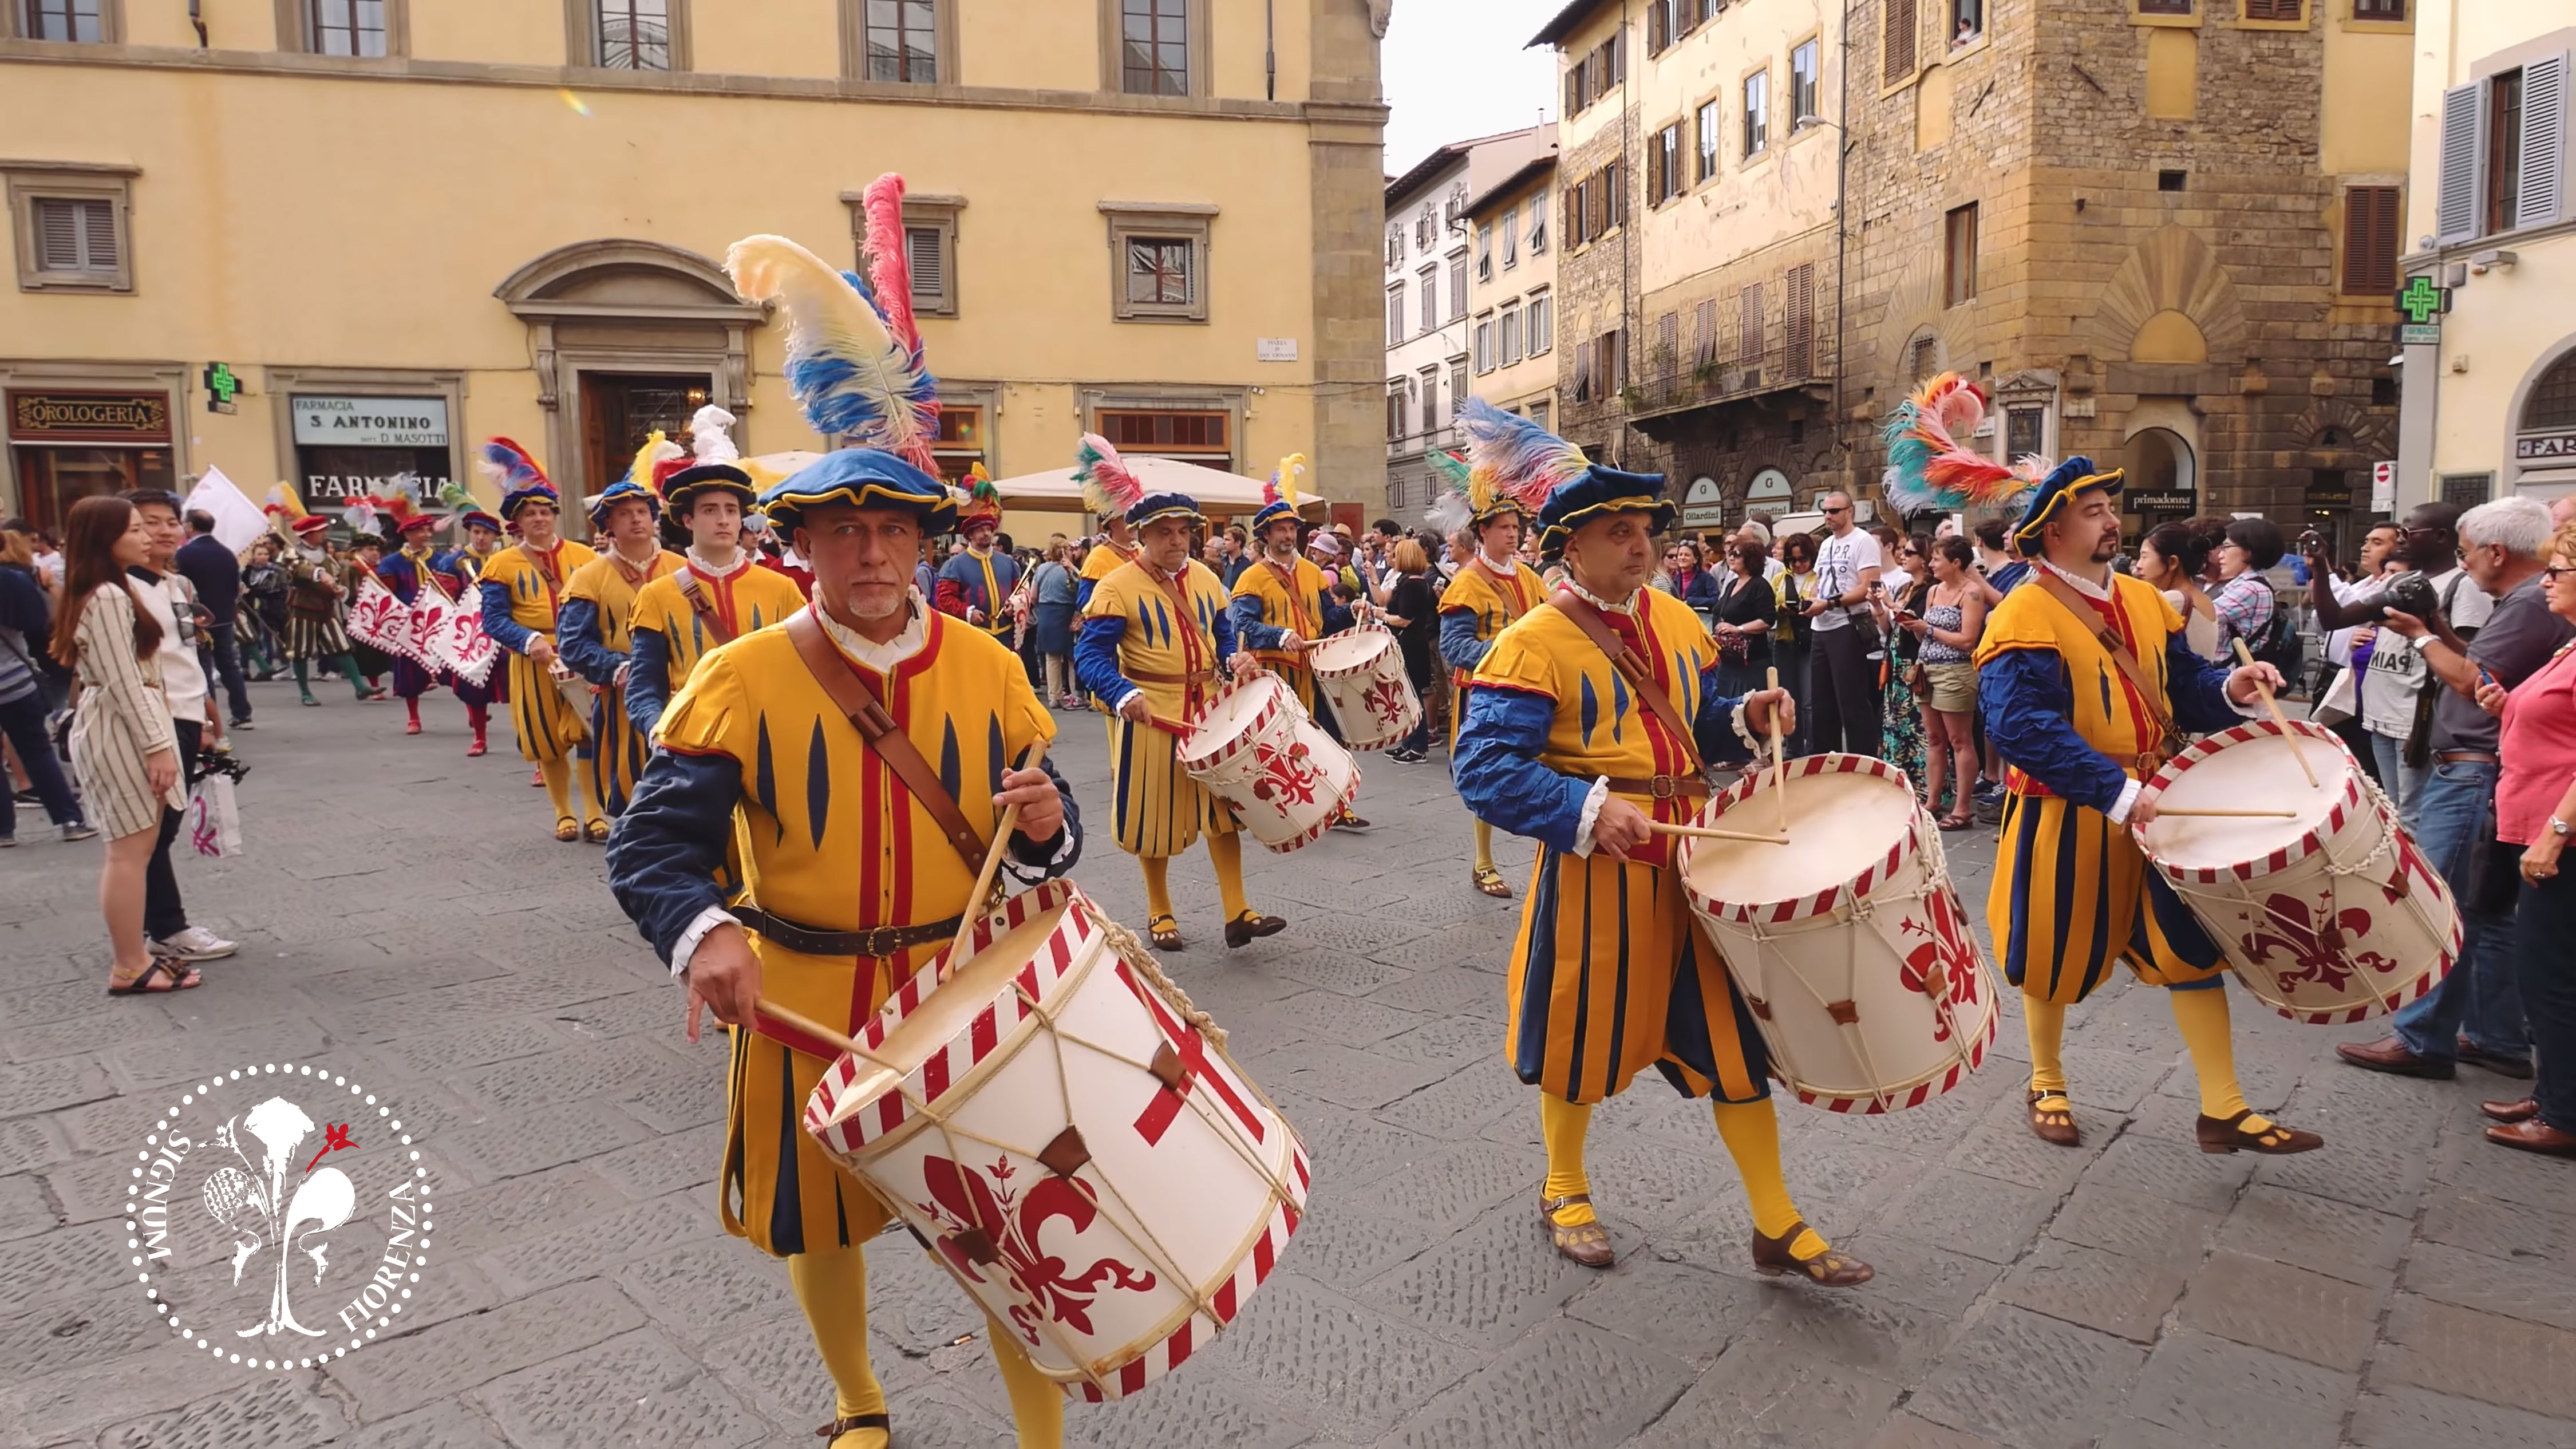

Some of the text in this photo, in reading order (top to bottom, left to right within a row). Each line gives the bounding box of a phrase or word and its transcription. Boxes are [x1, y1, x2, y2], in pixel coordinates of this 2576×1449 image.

[296, 400, 354, 411] FARMACIA
[33, 405, 148, 422] OROLOGERIA
[333, 416, 430, 429] ANTONINO
[394, 433, 446, 444] MASOTTI
[1765, 477, 1773, 488] G
[1700, 484, 1707, 495] G
[2134, 492, 2191, 509] primadonna
[1686, 510, 1718, 521] Gilardini
